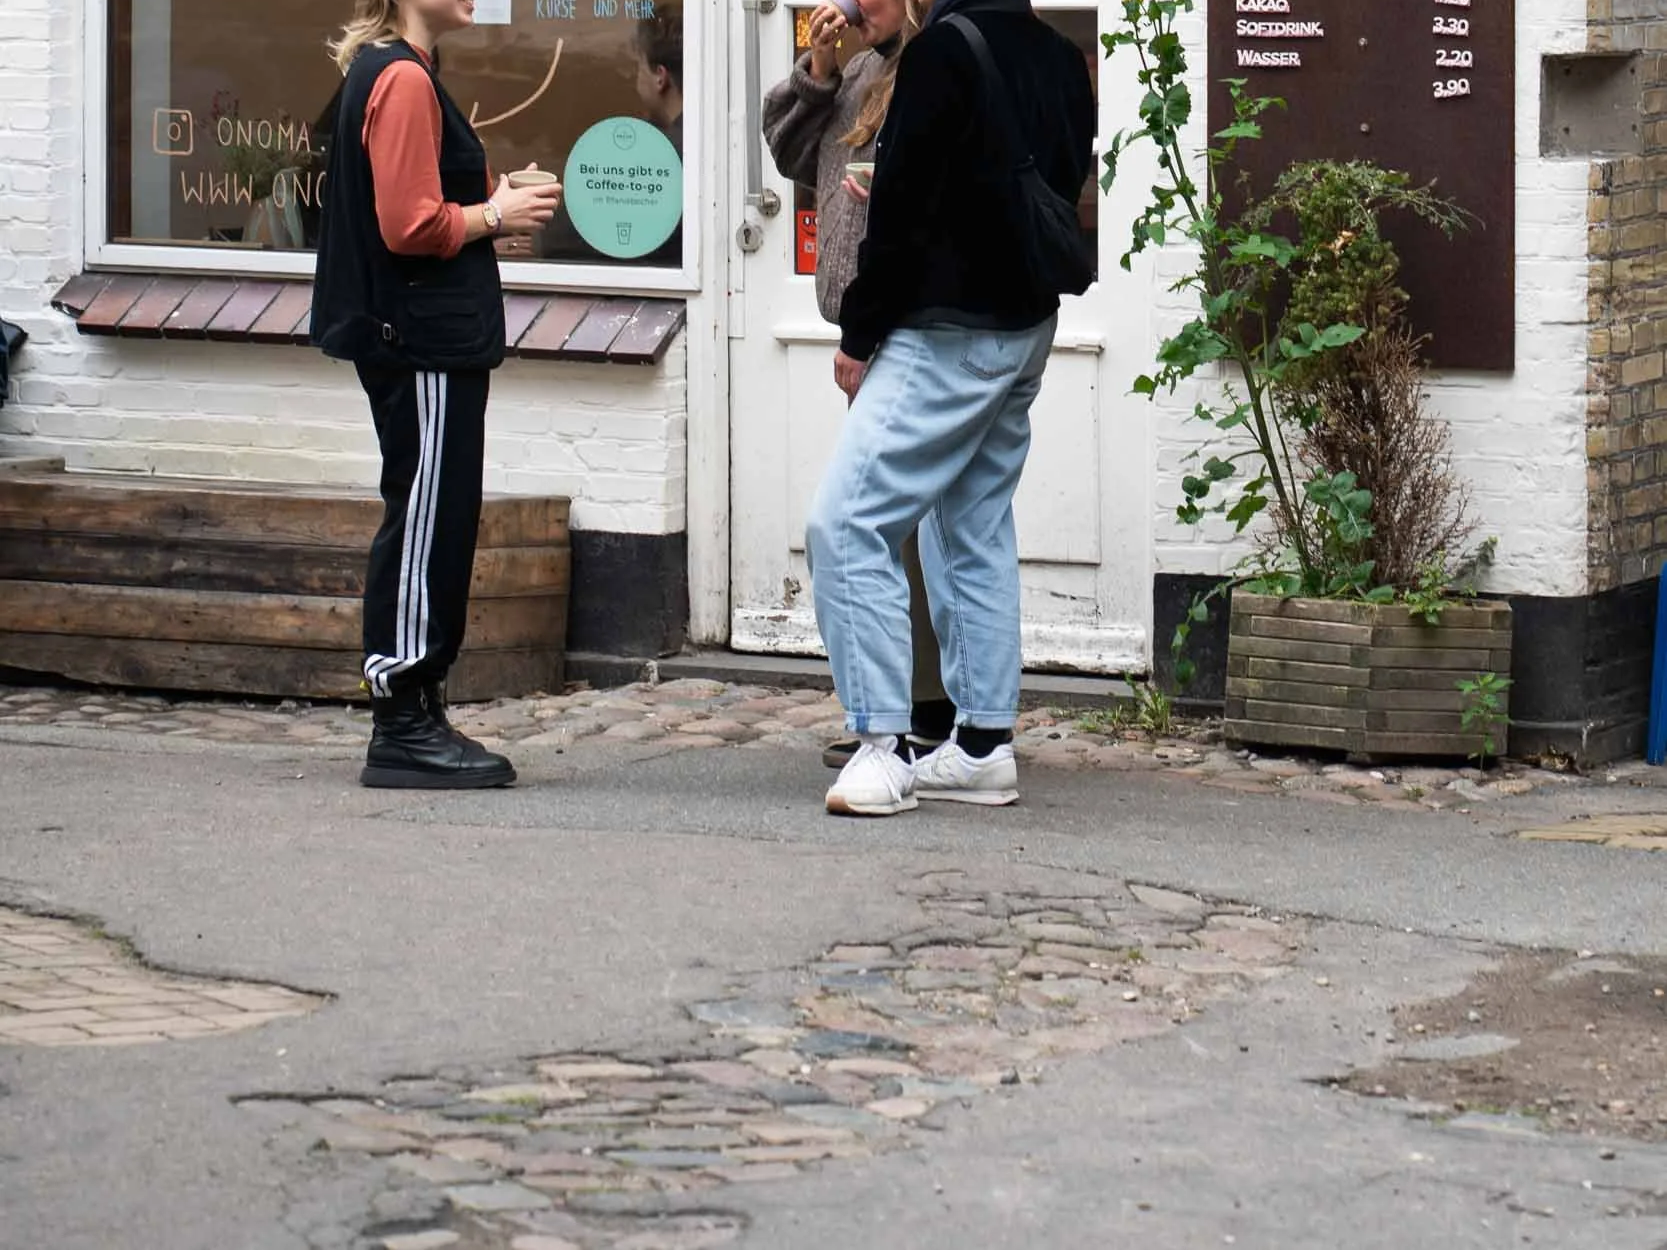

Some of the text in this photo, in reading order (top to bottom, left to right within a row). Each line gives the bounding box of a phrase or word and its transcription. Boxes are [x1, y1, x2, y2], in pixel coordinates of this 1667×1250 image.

[1235, 19, 1325, 38] SOFTDRINK
[1236, 49, 1302, 67] WASSER
[579, 163, 671, 179] Bei uns gibt es
[585, 178, 663, 195] Coffee-to-go
